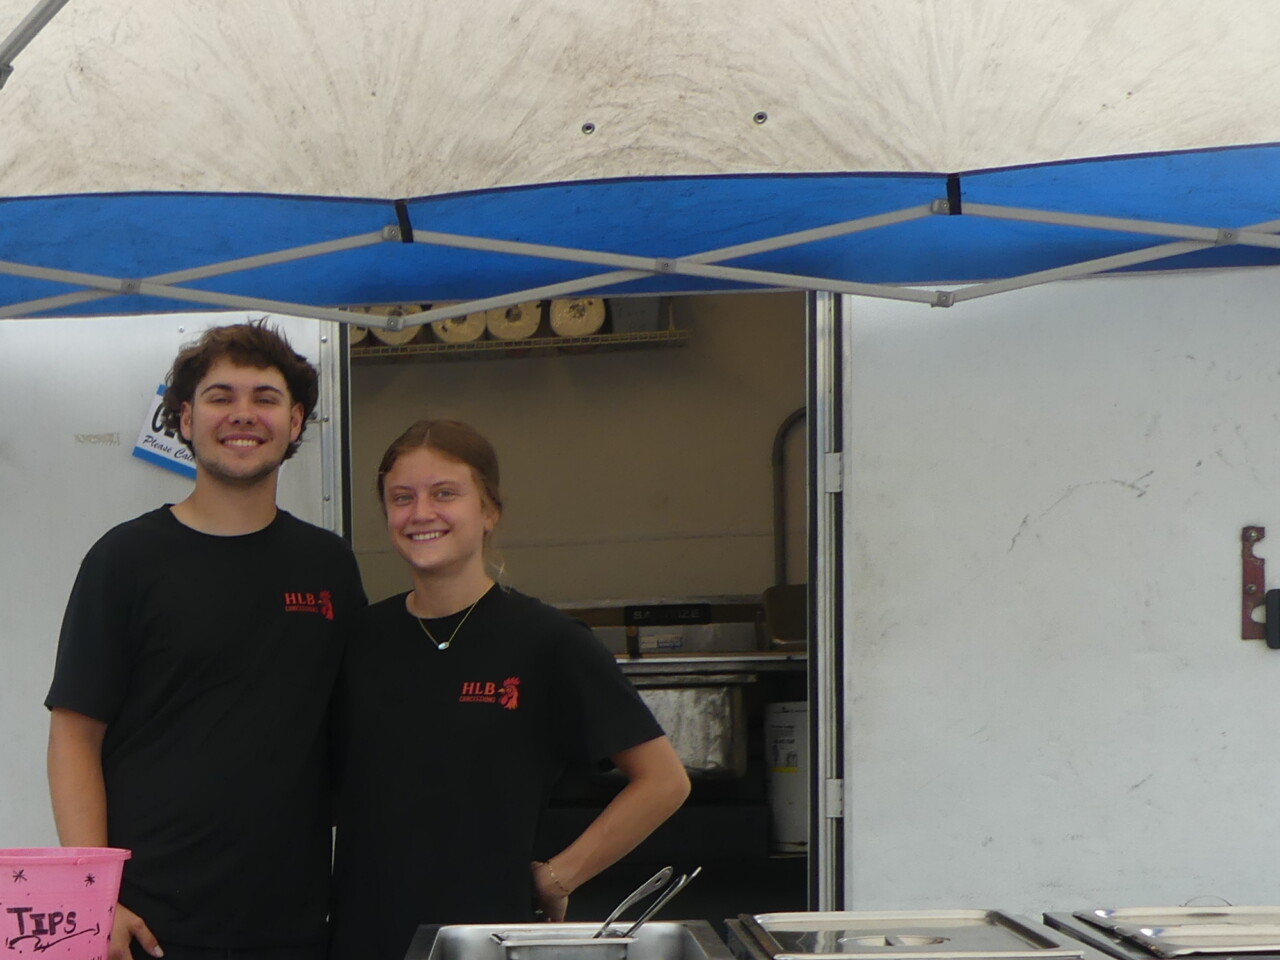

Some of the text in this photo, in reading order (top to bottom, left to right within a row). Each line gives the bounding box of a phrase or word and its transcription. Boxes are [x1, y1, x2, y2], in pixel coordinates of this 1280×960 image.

[143, 434, 172, 453] Please
[284, 592, 316, 605] HLB
[462, 681, 496, 695] HLB
